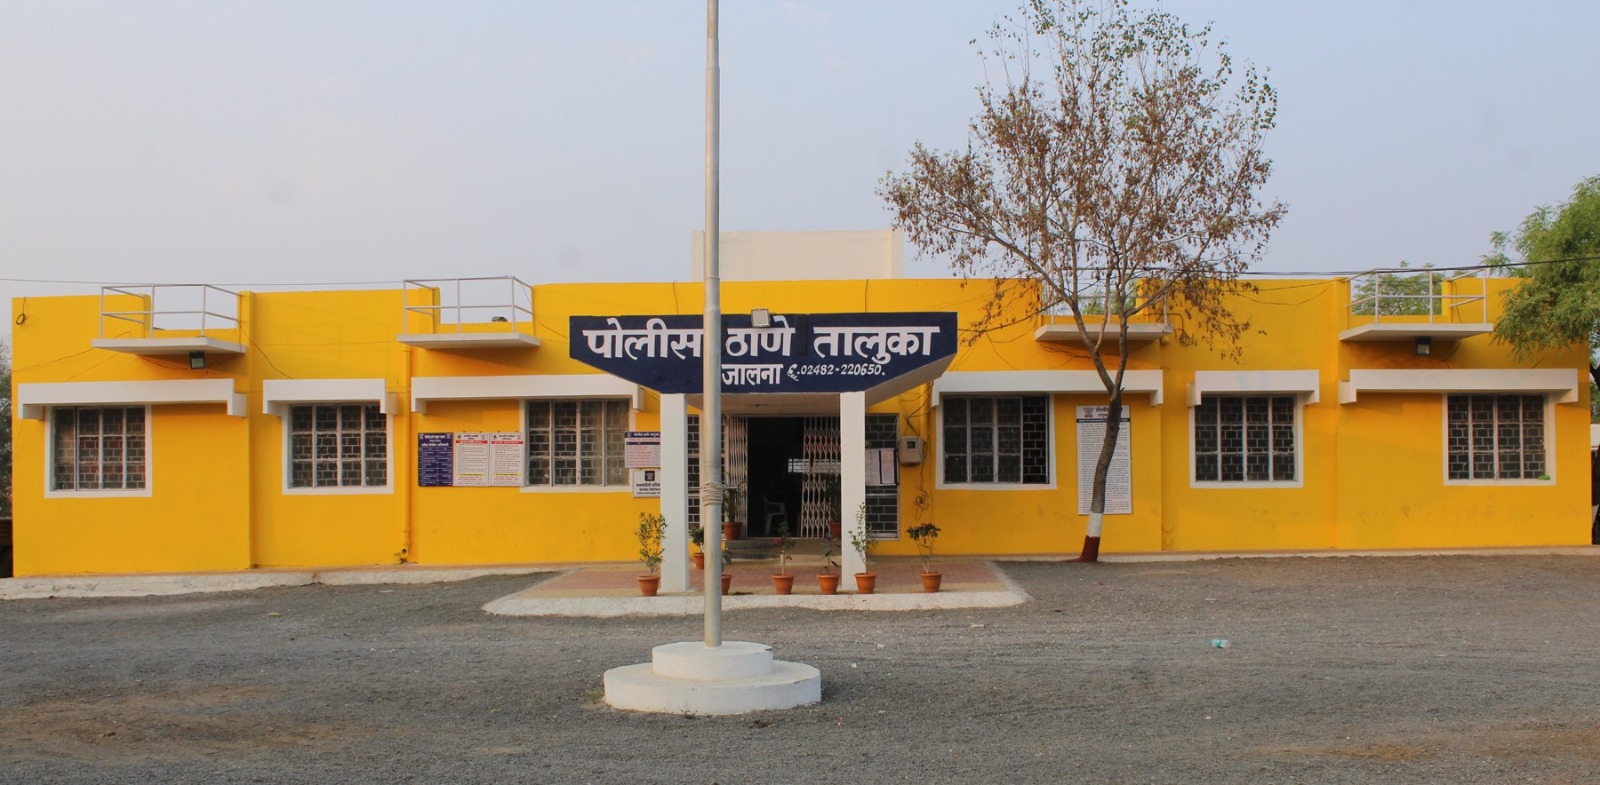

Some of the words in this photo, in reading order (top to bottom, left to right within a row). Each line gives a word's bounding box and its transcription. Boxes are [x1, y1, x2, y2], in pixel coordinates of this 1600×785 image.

[582, 317, 704, 361] पोलीस
[725, 315, 796, 357] ठाणे
[813, 326, 941, 365] तालुका
[721, 363, 784, 386] जालना
